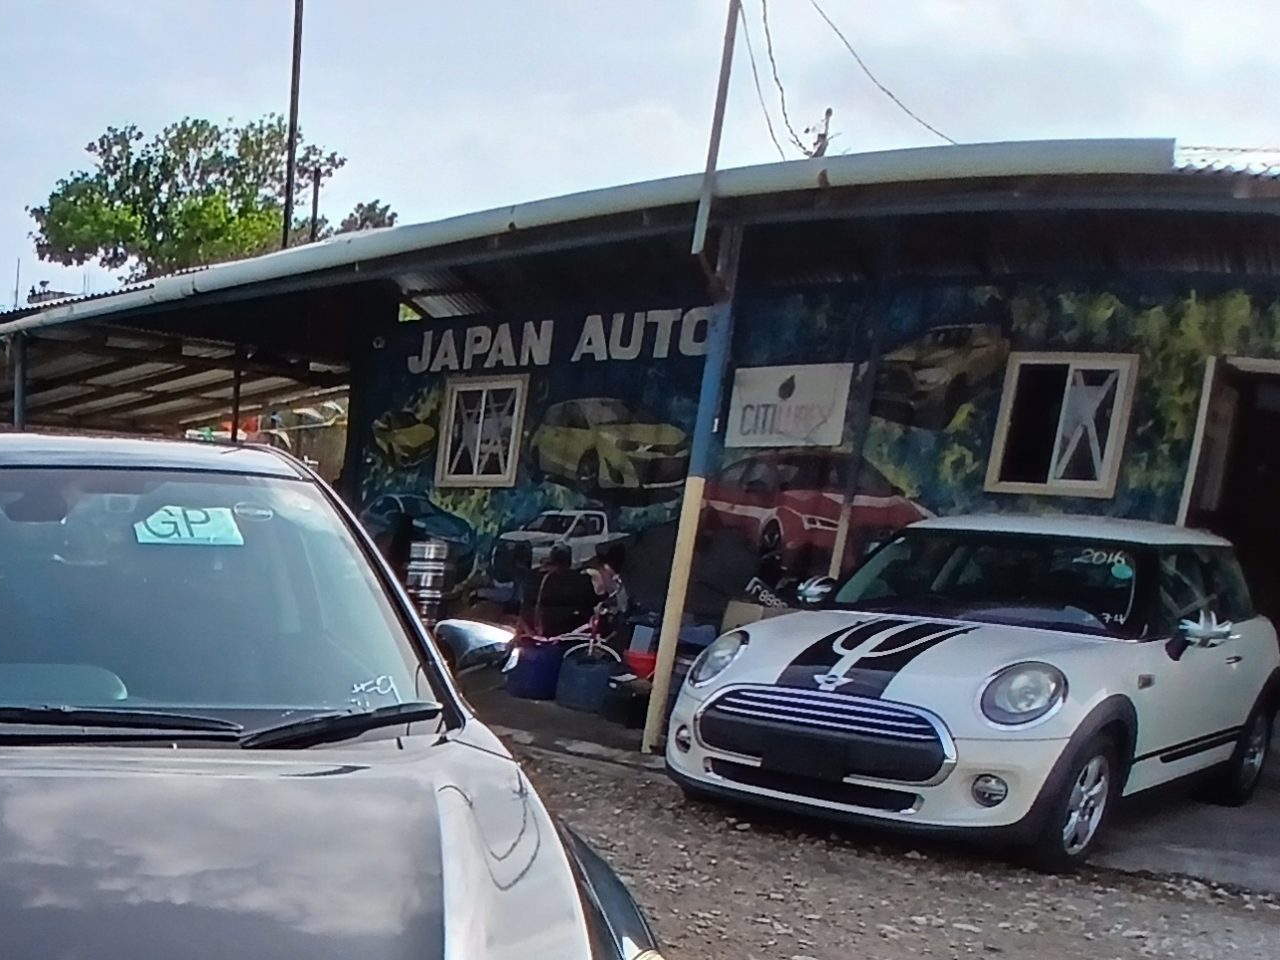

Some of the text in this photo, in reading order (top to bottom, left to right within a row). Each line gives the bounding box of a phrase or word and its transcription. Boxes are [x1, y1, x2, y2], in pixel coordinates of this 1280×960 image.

[407, 305, 716, 374] JAPAN AUTO
[1072, 548, 1126, 565] 2016
